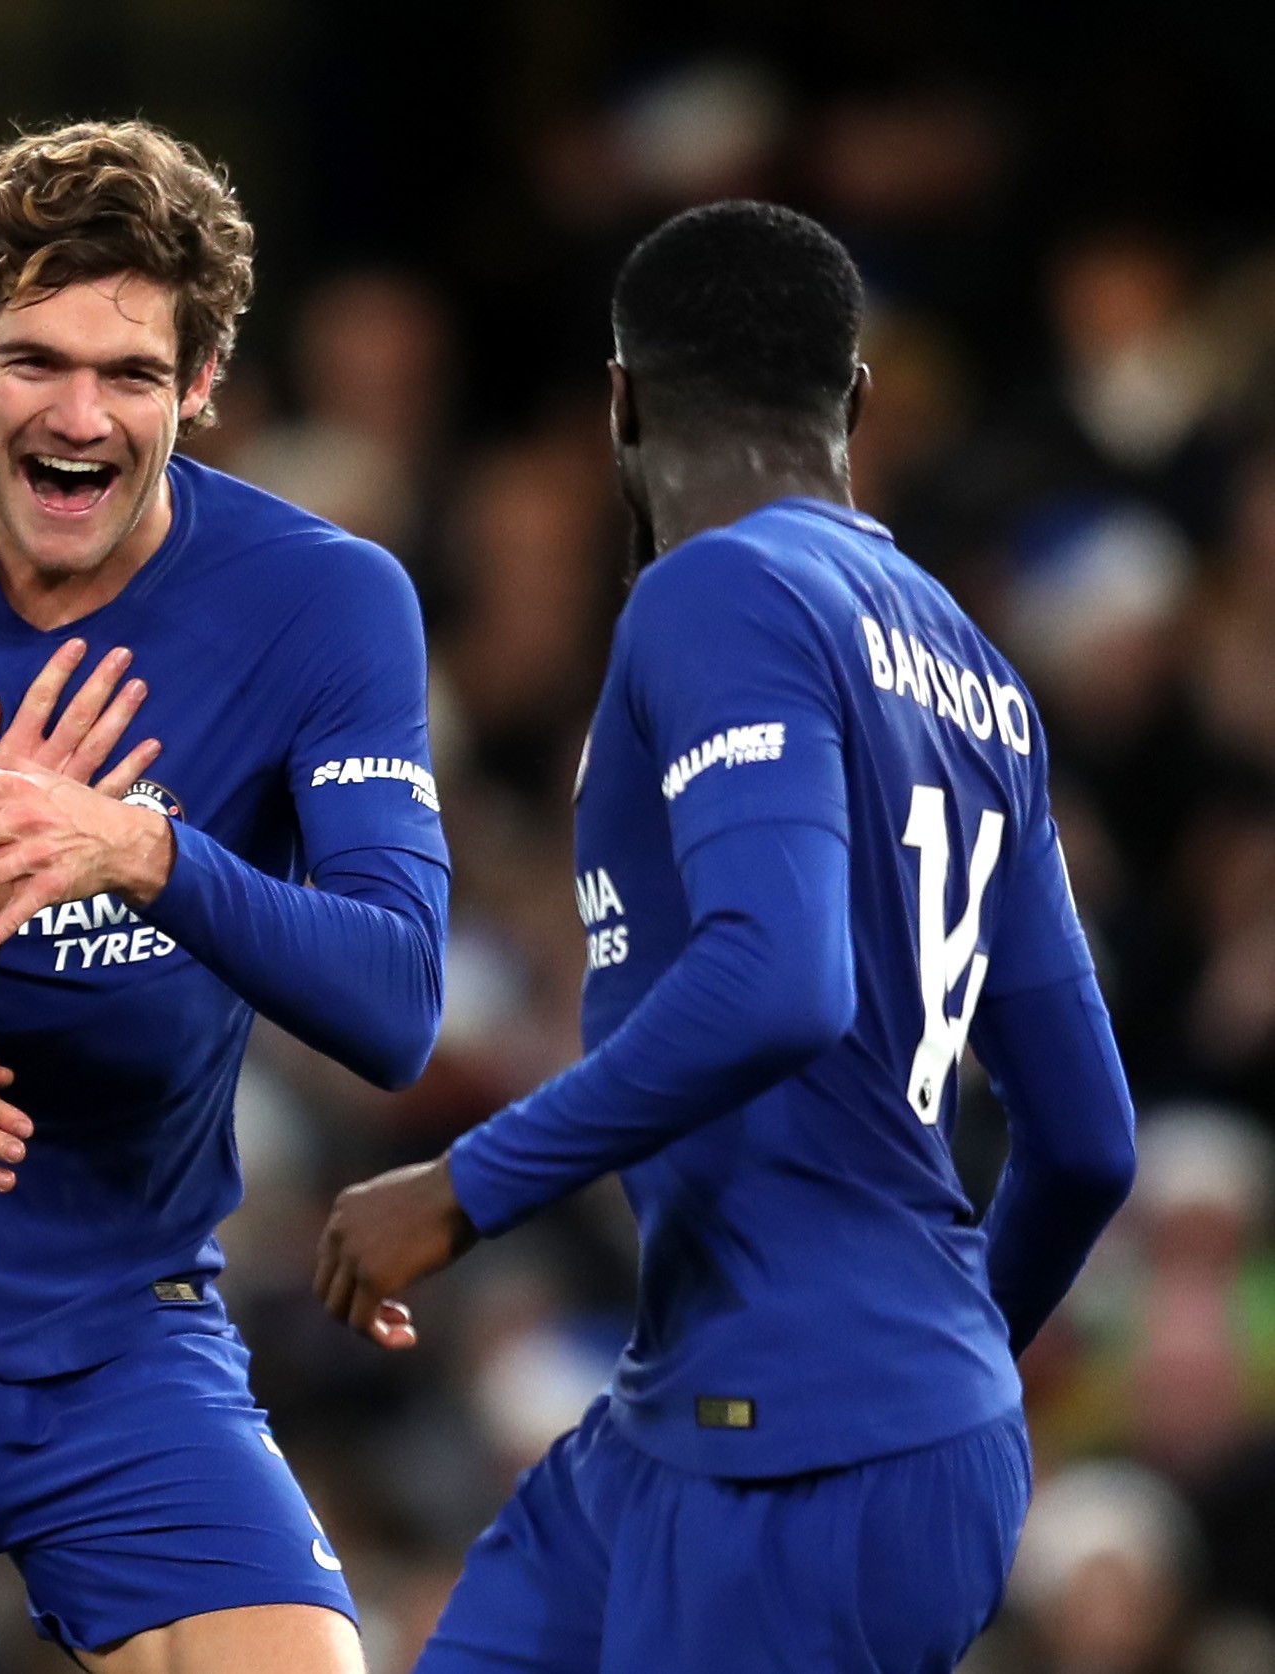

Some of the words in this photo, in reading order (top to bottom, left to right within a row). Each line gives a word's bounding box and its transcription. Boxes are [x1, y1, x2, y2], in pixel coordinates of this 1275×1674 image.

[124, 783, 163, 801] LSEA
[18, 893, 142, 936] HAM
[575, 866, 625, 928] MA
[53, 927, 176, 972] TYRES
[587, 924, 629, 971] RES
[901, 784, 1006, 1126] 14
